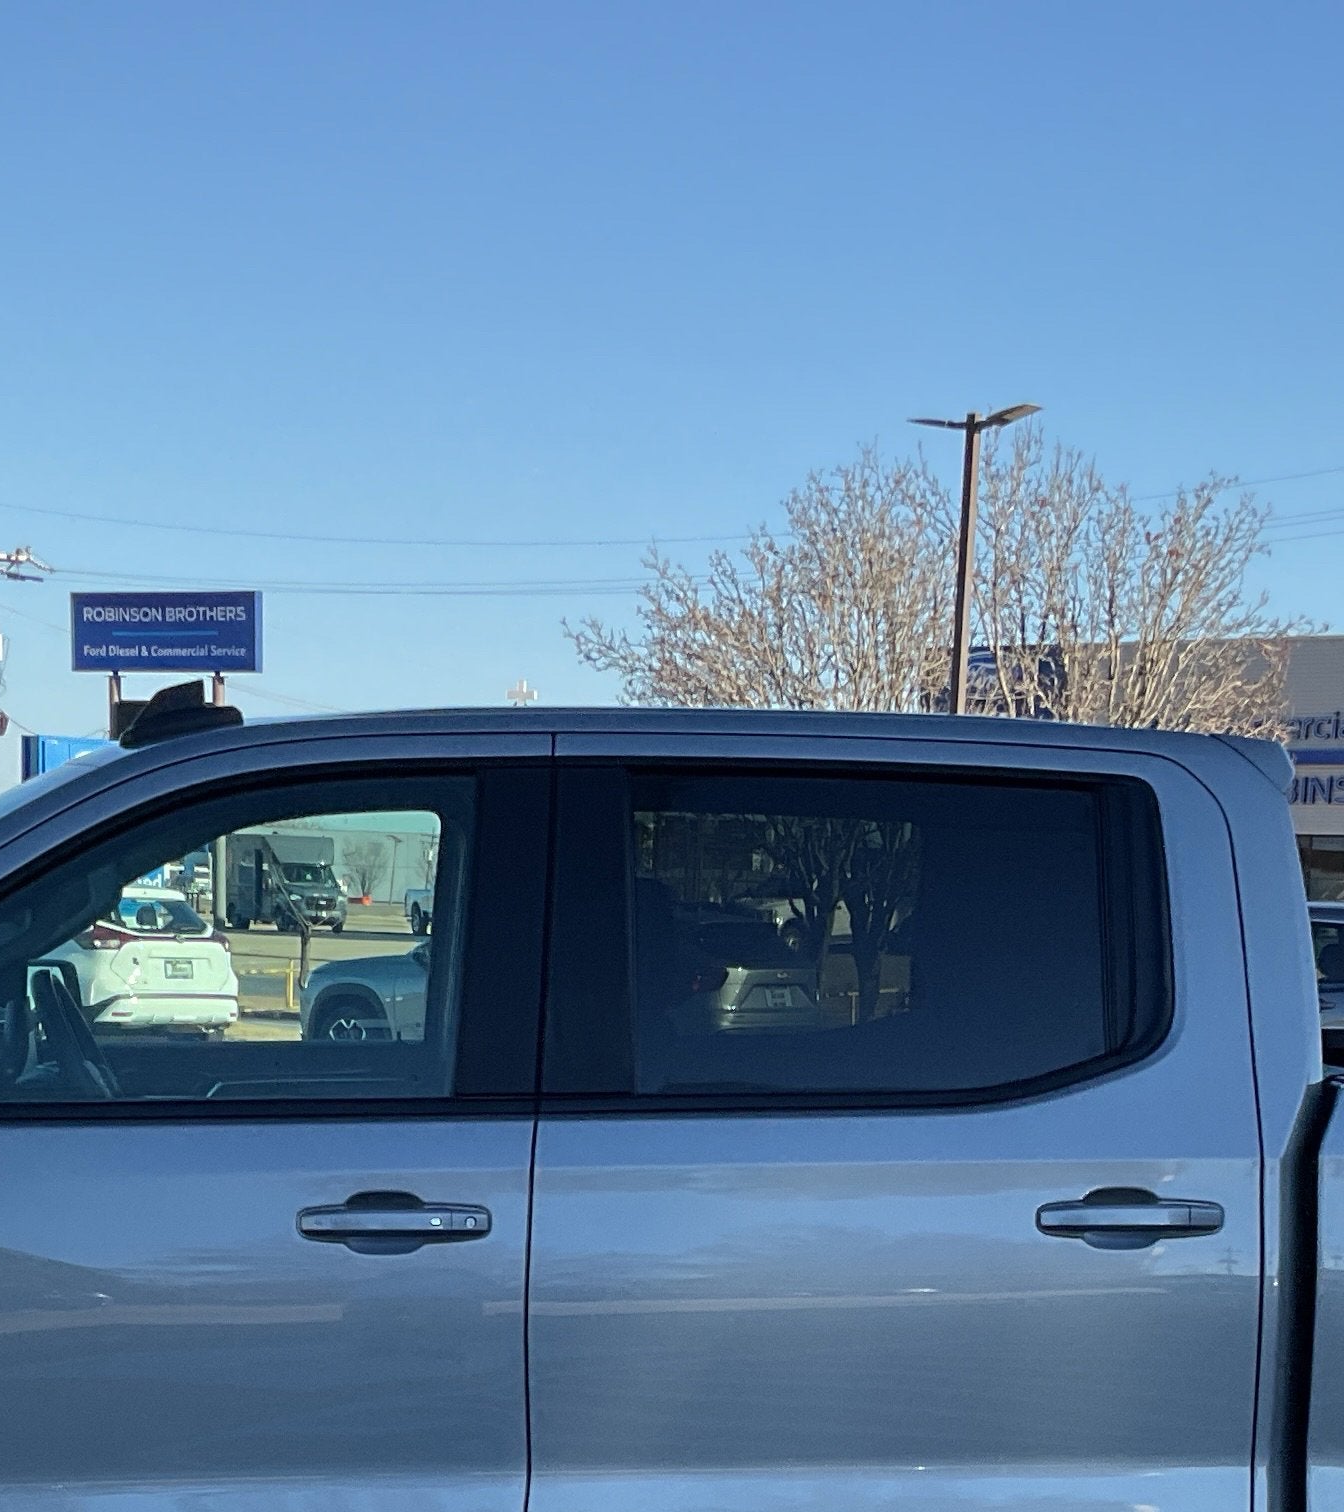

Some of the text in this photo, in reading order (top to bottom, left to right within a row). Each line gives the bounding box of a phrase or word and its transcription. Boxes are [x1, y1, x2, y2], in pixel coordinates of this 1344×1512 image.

[83, 606, 246, 622] ROBINSON BROTHERS
[83, 644, 246, 657] Ford Diesel & Commercial Service
